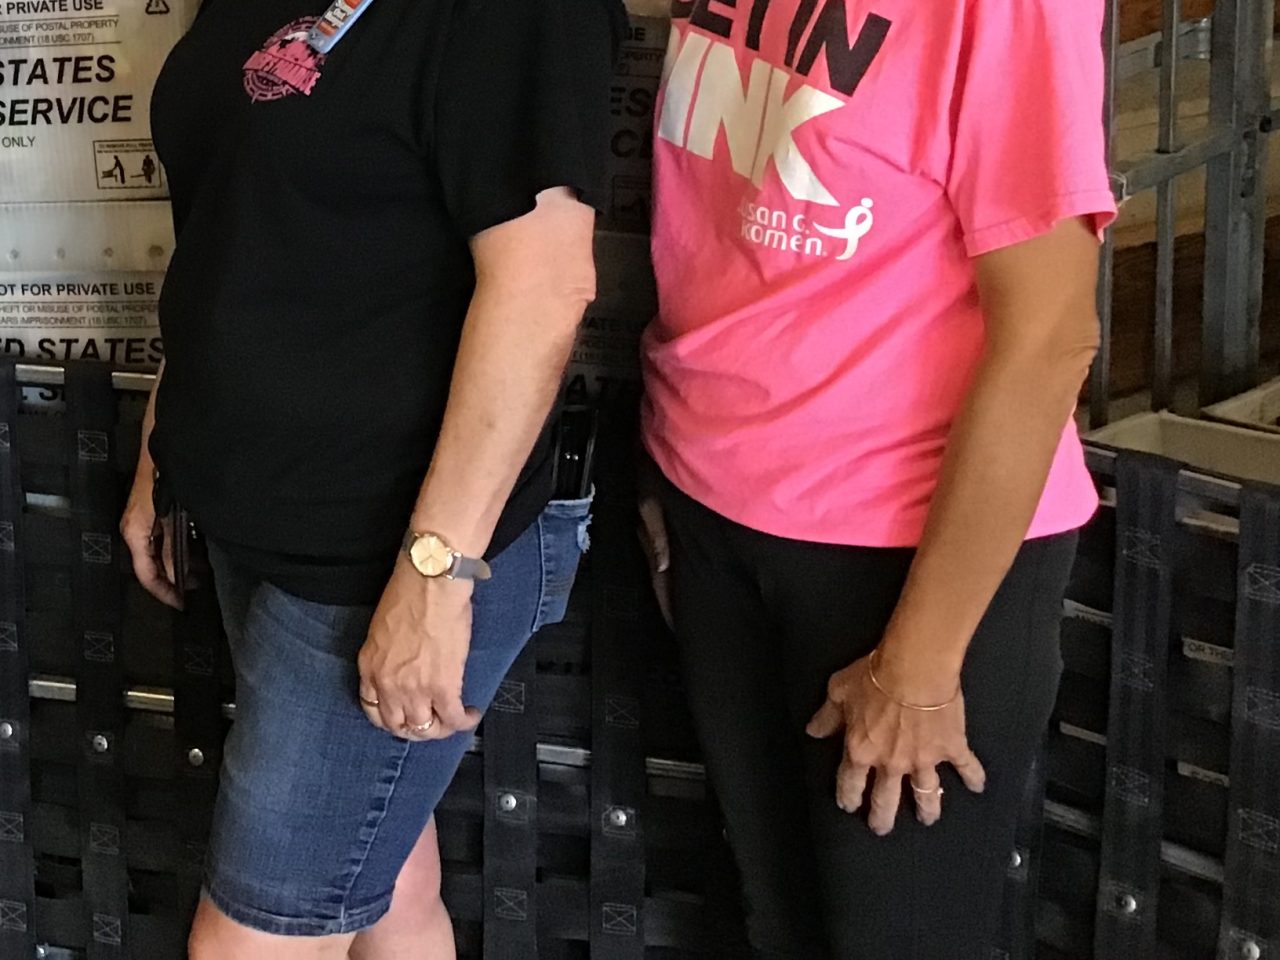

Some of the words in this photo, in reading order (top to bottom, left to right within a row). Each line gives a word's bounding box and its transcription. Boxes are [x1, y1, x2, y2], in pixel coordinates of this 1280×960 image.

[6, 0, 69, 15] PRIVATE
[22, 23, 34, 32] OF
[35, 21, 69, 32] POSTAL
[70, 19, 119, 30] PROPERTY
[50, 34, 70, 43] USC
[658, 25, 846, 208] INK
[1, 136, 36, 148] ONLY
[738, 200, 787, 230] usan
[21, 283, 52, 296] FOR
[56, 282, 119, 296] PRIVATE
[124, 282, 156, 296] USE
[23, 305, 36, 313] OR
[72, 304, 84, 313] OF
[36, 338, 164, 364] STATES
